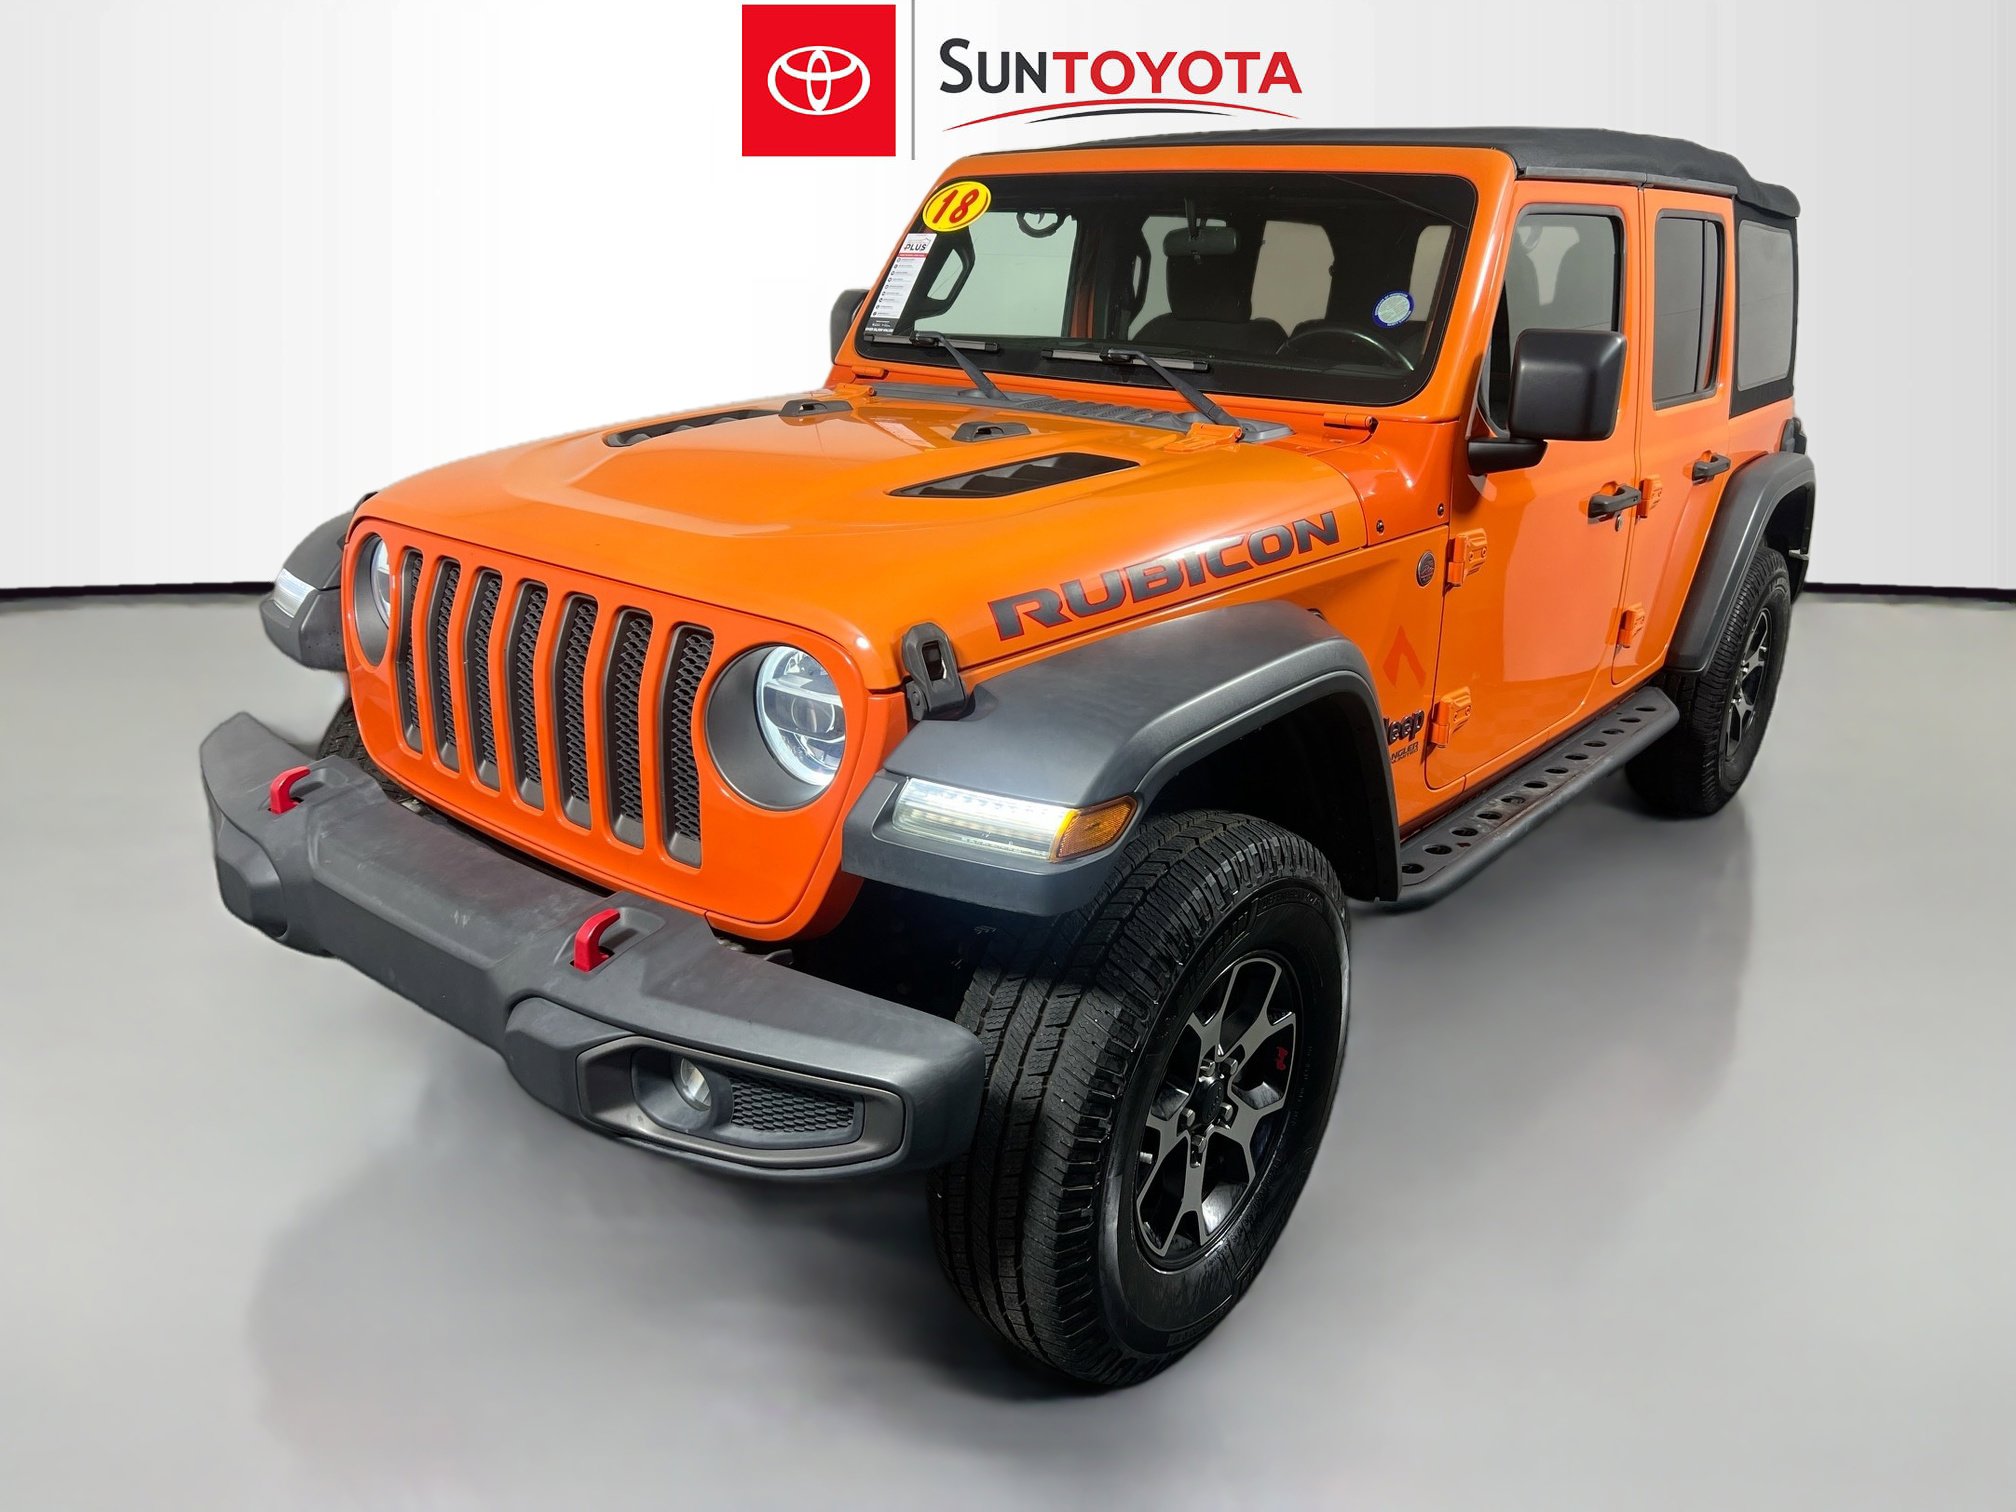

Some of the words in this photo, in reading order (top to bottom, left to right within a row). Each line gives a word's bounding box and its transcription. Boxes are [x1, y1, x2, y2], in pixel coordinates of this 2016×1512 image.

[932, 188, 980, 224] 18
[903, 243, 927, 251] PLUS
[986, 511, 1341, 641] RUBICON
[1390, 742, 1419, 761] NGLER
